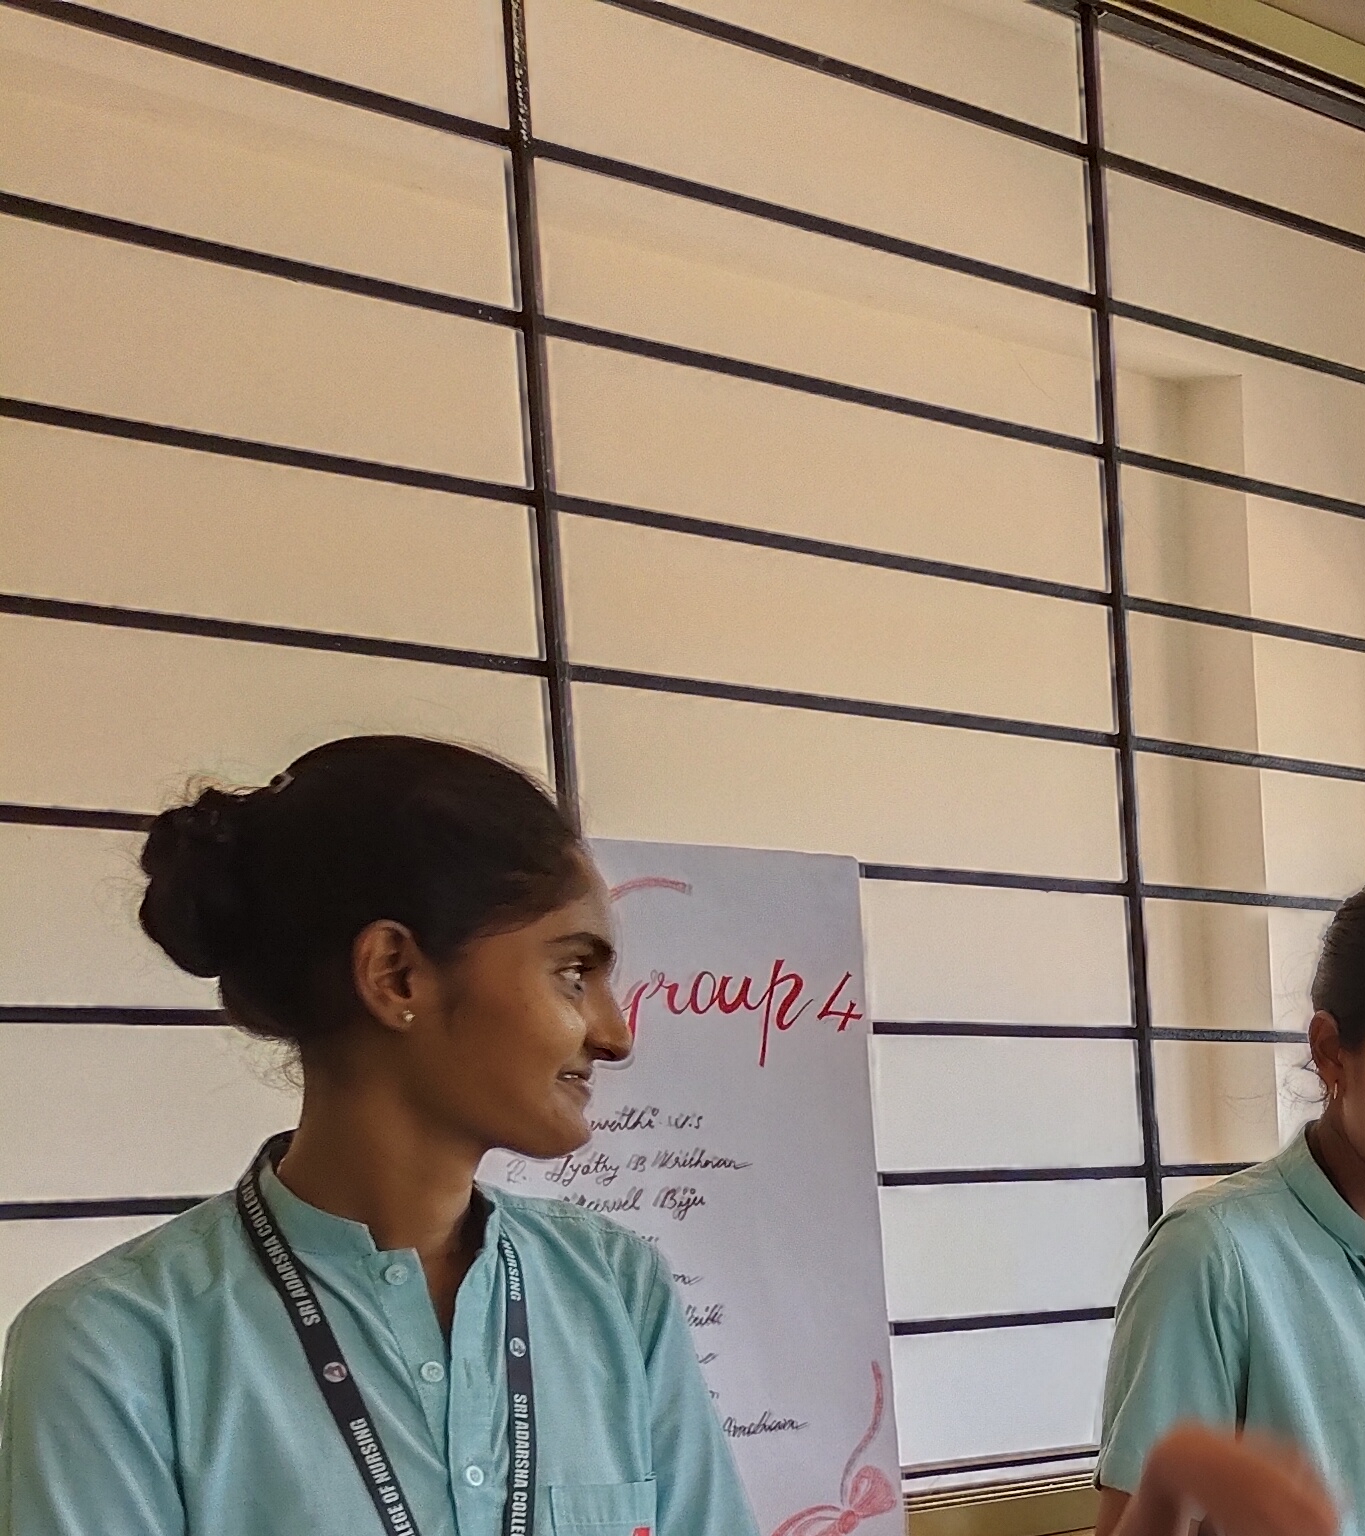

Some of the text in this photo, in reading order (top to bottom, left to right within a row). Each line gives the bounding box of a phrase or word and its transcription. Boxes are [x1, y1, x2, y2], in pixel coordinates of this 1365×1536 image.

[817, 971, 863, 1032] 4
[513, 1393, 528, 1418] SRI
[350, 1417, 392, 1485] NURSING
[513, 1420, 530, 1489] ADARSHA
[379, 1485, 400, 1504] OF
